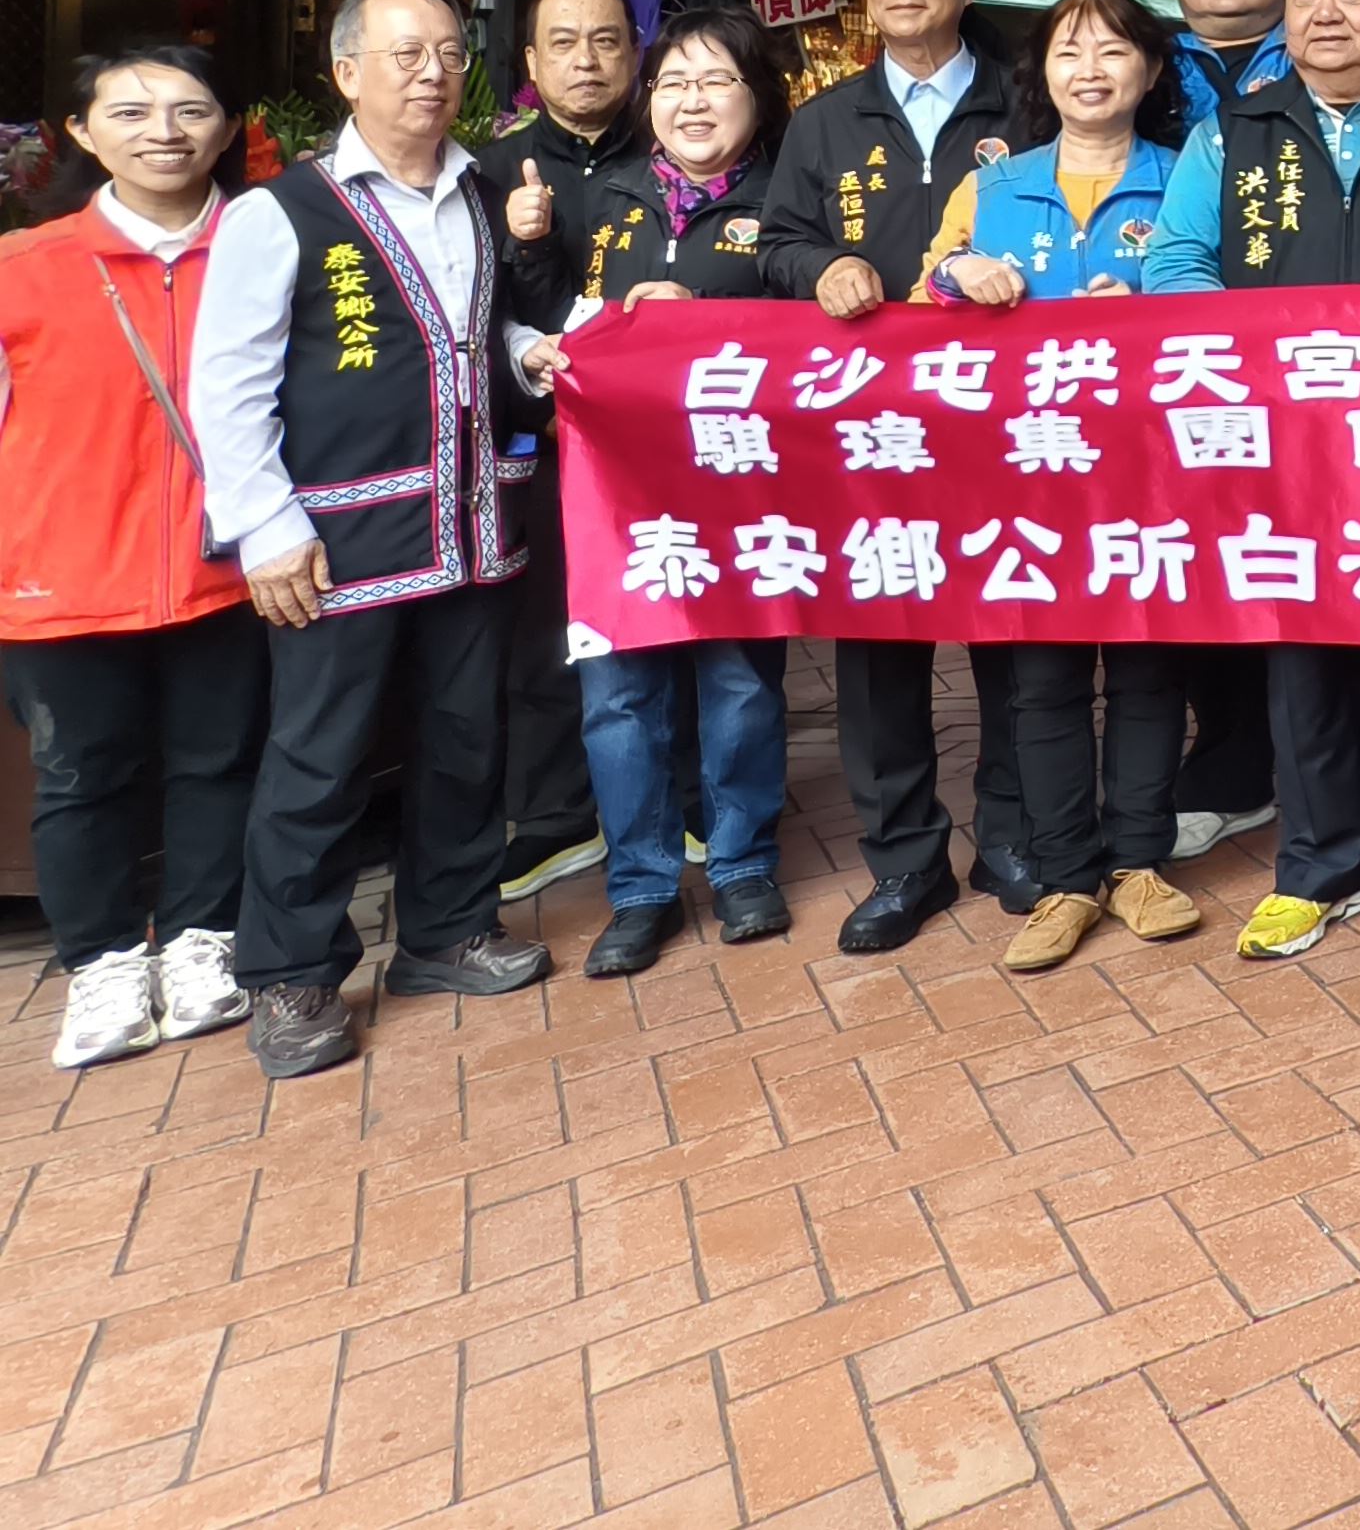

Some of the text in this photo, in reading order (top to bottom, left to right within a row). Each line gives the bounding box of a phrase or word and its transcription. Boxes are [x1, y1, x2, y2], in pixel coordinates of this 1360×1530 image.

[1235, 165, 1276, 270] 洪文華
[1275, 138, 1306, 231] 主任委員
[323, 243, 380, 371] 泰安鄉公所
